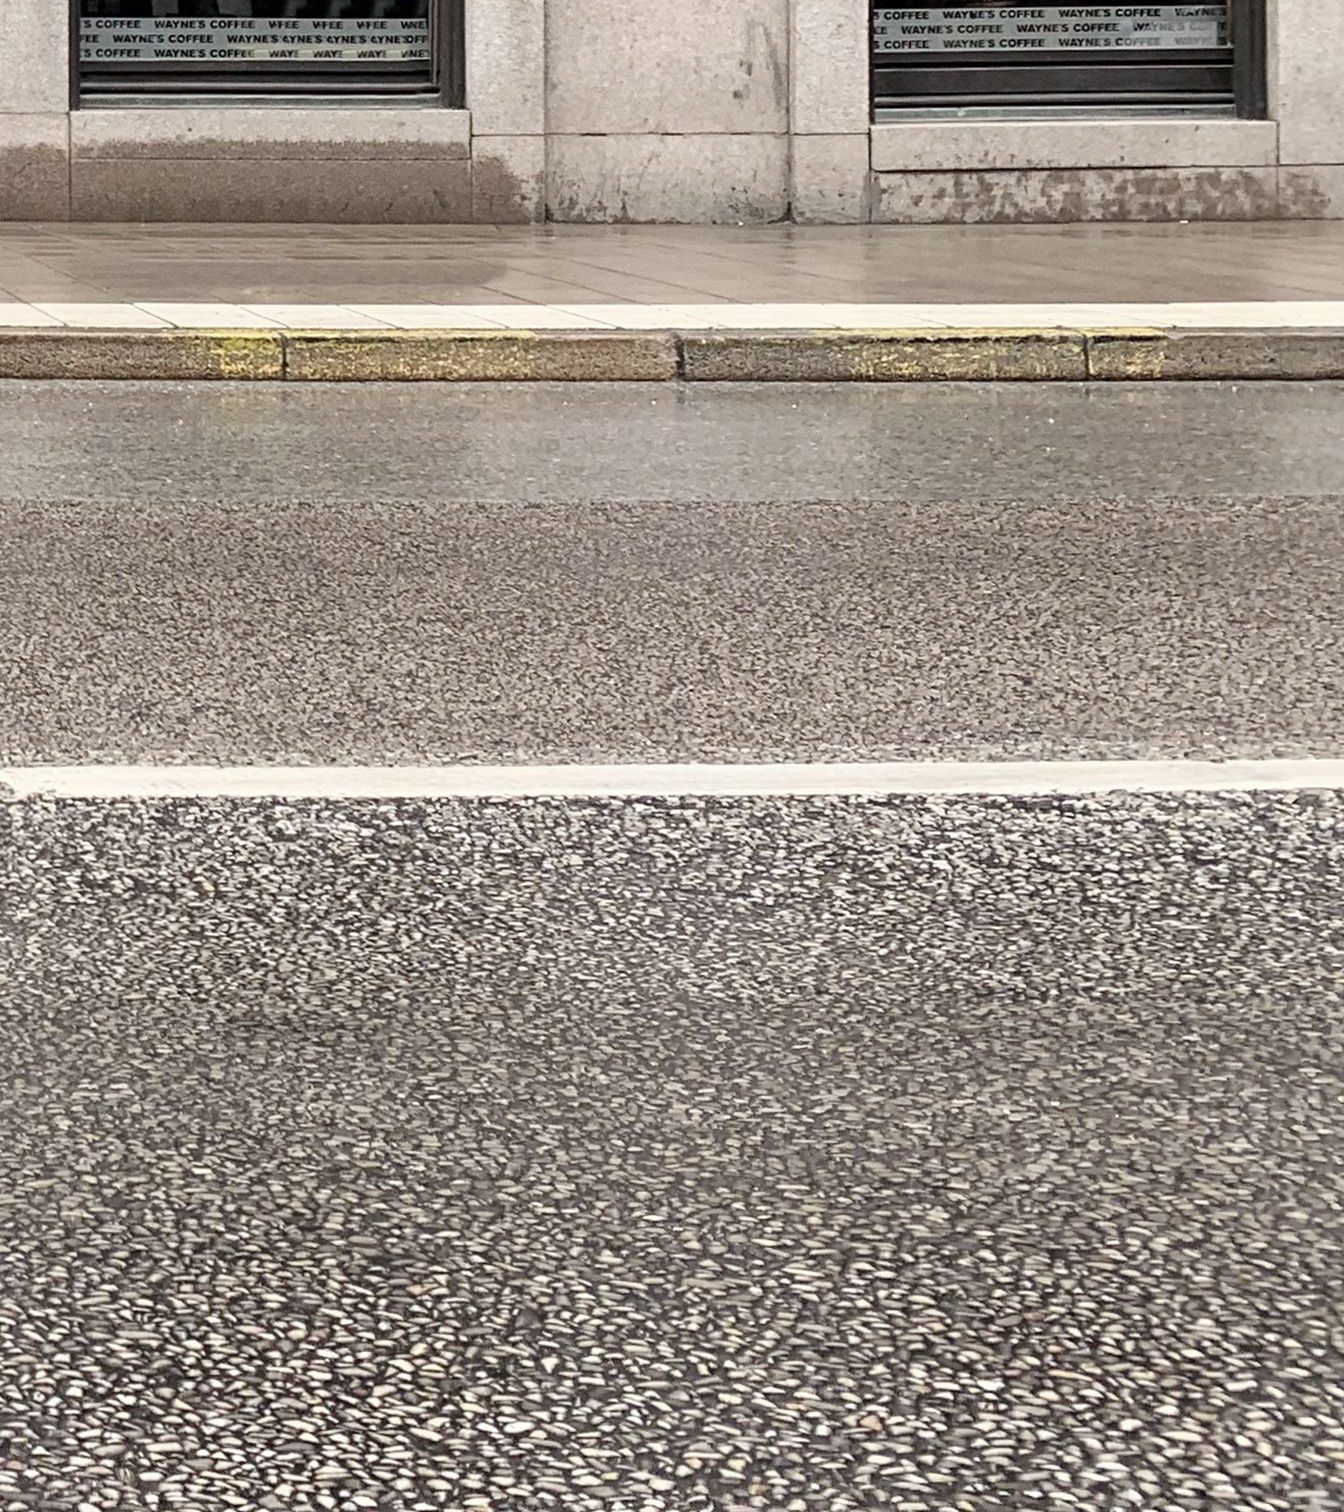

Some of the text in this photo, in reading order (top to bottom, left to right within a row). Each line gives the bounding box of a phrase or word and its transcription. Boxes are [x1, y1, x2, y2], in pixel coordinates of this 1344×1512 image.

[884, 11, 929, 20] COFFEE
[943, 10, 995, 19] WAYNE'S
[999, 9, 1045, 19] COFFEE
[1058, 9, 1111, 18] WAYNE'S
[1115, 8, 1160, 18] COFFEE
[95, 20, 141, 29] COFFEE
[154, 20, 206, 29] WAYNE'S
[210, 20, 255, 29] COFFEE
[901, 25, 953, 34] WAYNE'S
[957, 24, 1003, 34] COFFEE
[1016, 23, 1069, 33] WAYNE'S
[1073, 22, 1120, 32] COFFEE
[113, 34, 164, 43] WAYNE'S
[168, 34, 214, 43] COFFEE
[226, 34, 278, 43] WAYNE'S
[884, 40, 929, 49] COFFEE
[943, 39, 995, 48] WAYNE'S
[999, 39, 1045, 48] COFFEE
[1058, 38, 1111, 47] WAYNE'S
[95, 48, 141, 57] COFFEE
[154, 48, 206, 58] WAYNE'S
